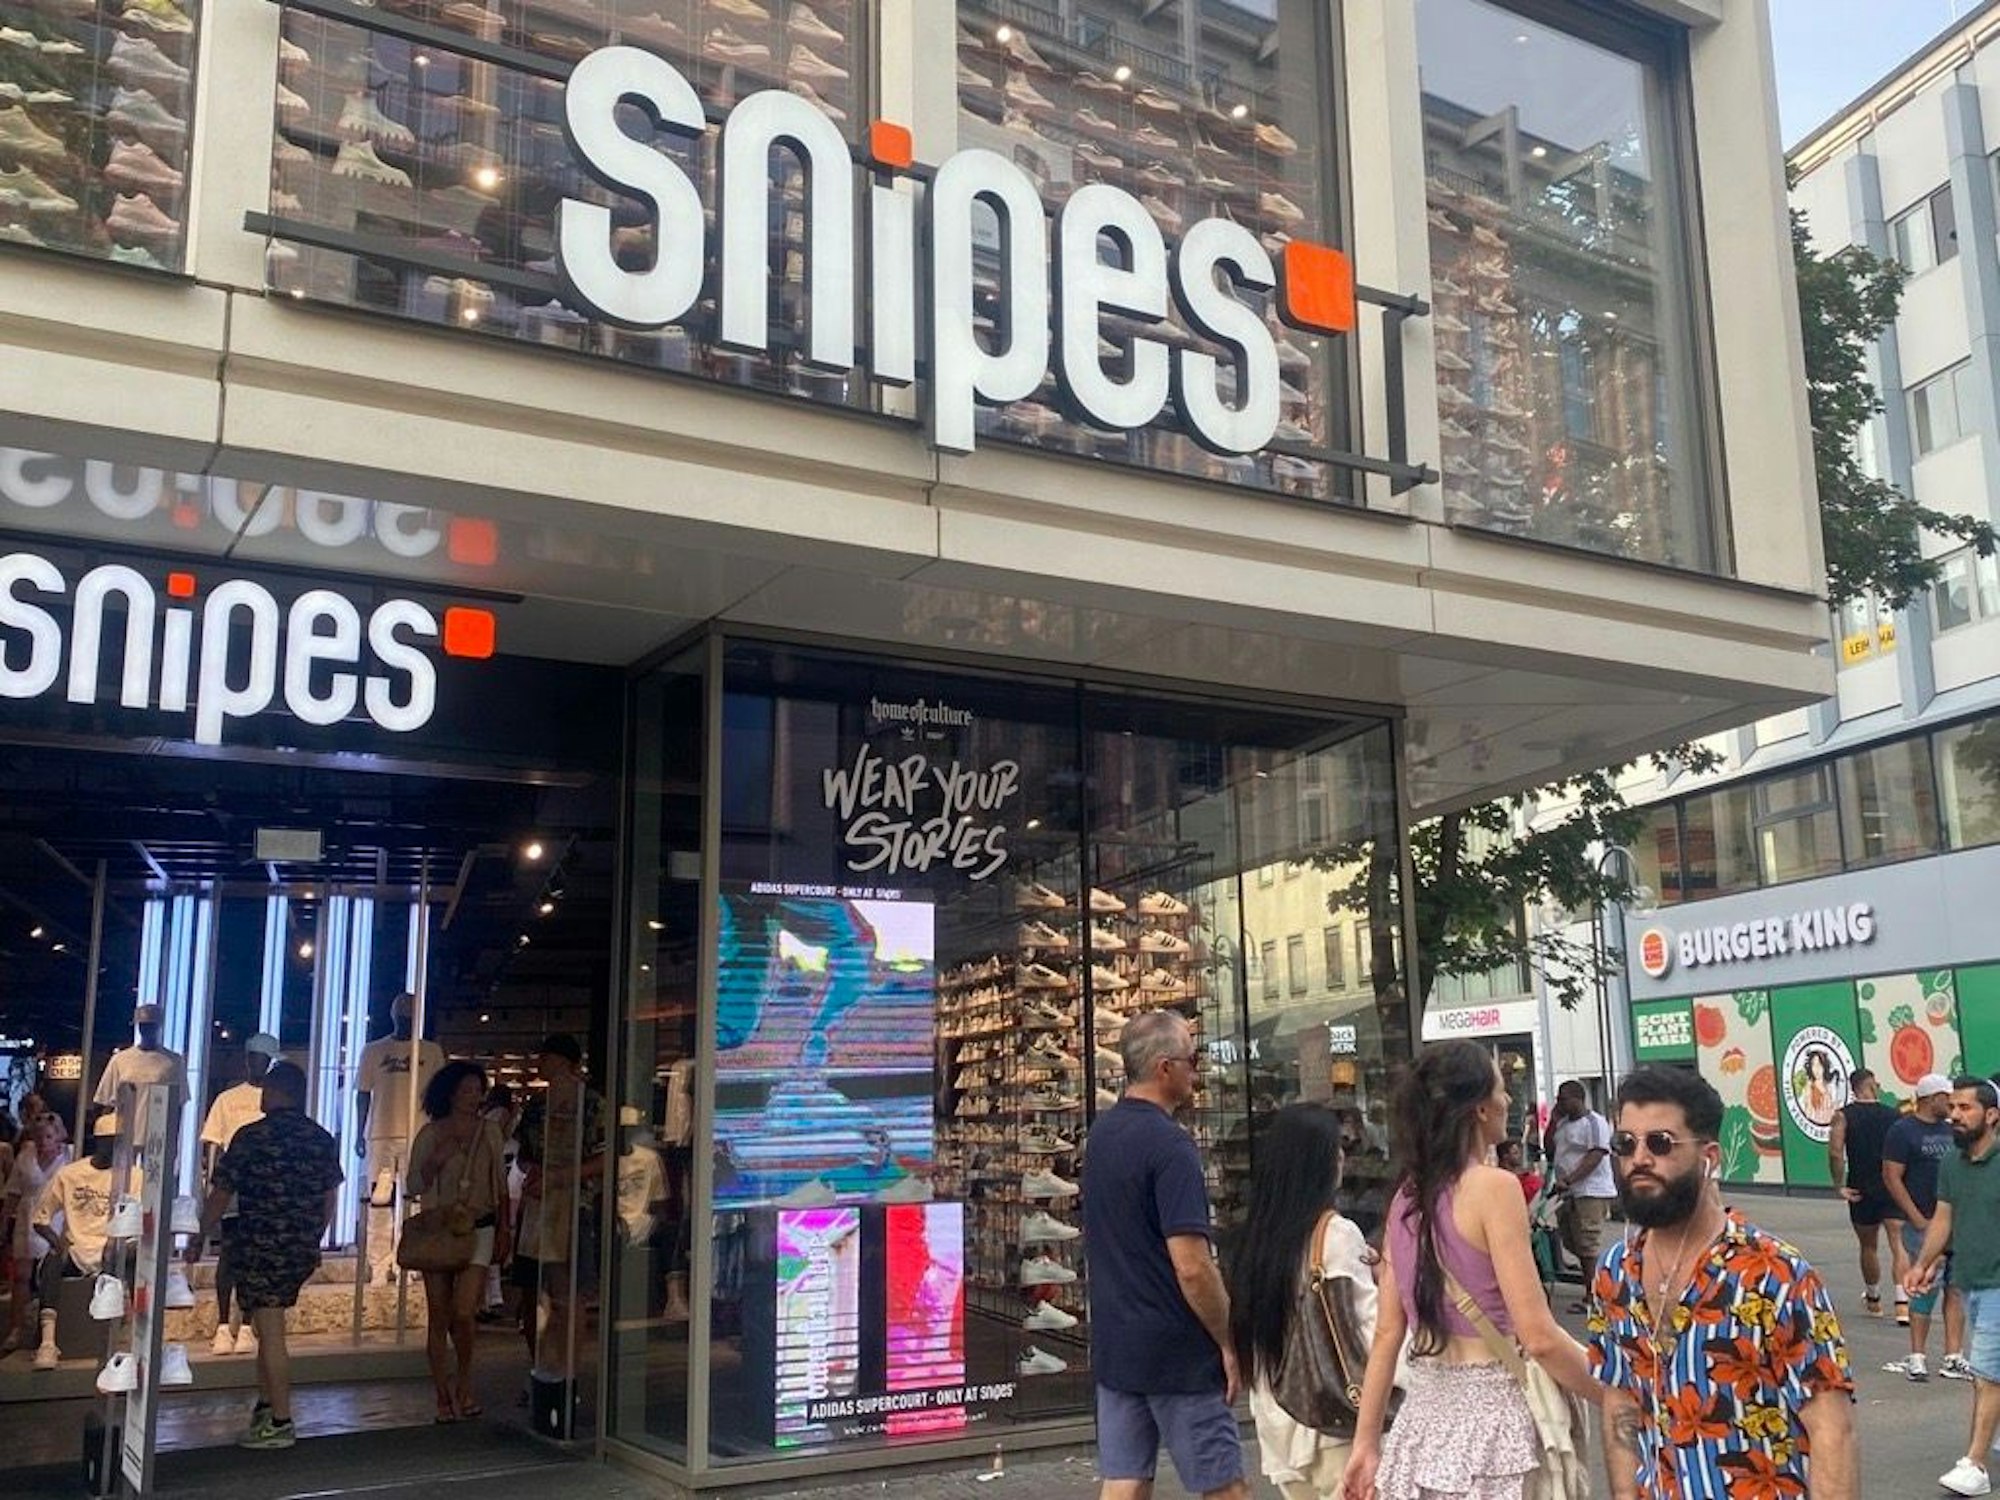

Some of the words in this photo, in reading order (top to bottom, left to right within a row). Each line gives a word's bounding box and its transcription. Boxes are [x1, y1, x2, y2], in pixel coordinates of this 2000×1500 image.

[560, 45, 1282, 454] snipes
[0, 552, 438, 745] snipes
[823, 743, 929, 819] WEAR
[932, 760, 1019, 819] YOUR
[845, 811, 1008, 880] STORIES
[751, 881, 783, 894] ADIDAS
[783, 883, 837, 897] SUPERCOURT
[842, 887, 862, 898] ONLY
[863, 889, 874, 898] AT
[1678, 918, 1786, 966] BURGER
[1790, 903, 1872, 951] KING
[1638, 1022, 1691, 1037] PLANT
[1639, 1034, 1692, 1048] BASED
[1791, 1029, 1829, 1053] POWERED
[1831, 1036, 1843, 1049] BY
[811, 1400, 854, 1419] ADIDAS
[856, 1394, 928, 1414] SUPERCOURT
[936, 1389, 963, 1406] ONLY
[963, 1388, 979, 1402] AT
